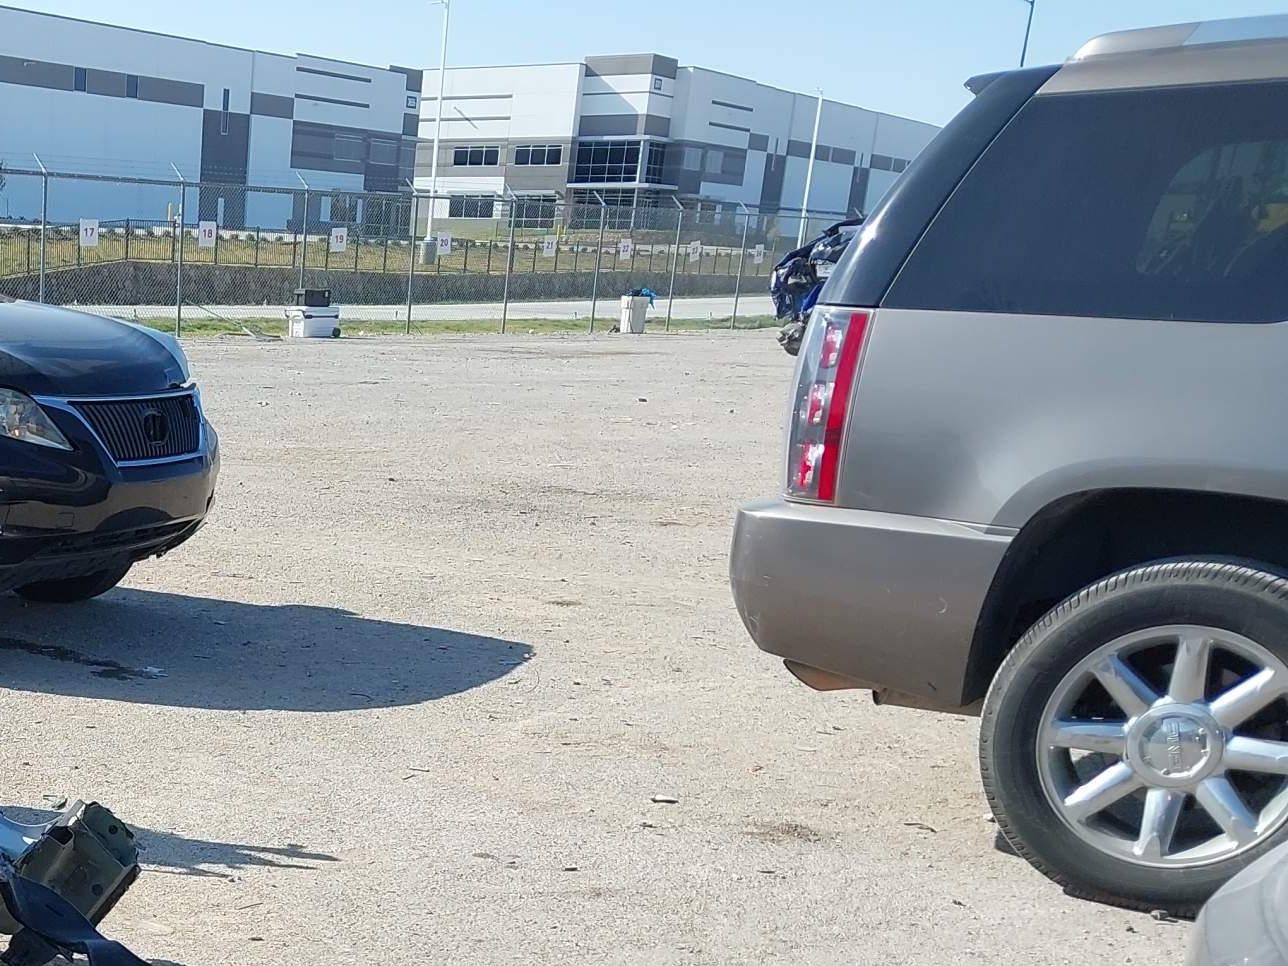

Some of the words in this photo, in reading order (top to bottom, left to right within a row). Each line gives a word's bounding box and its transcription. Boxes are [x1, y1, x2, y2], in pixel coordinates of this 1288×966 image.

[83, 227, 95, 238] 17
[202, 229, 213, 239] 18
[335, 235, 344, 244] 19
[439, 239, 449, 247] 20
